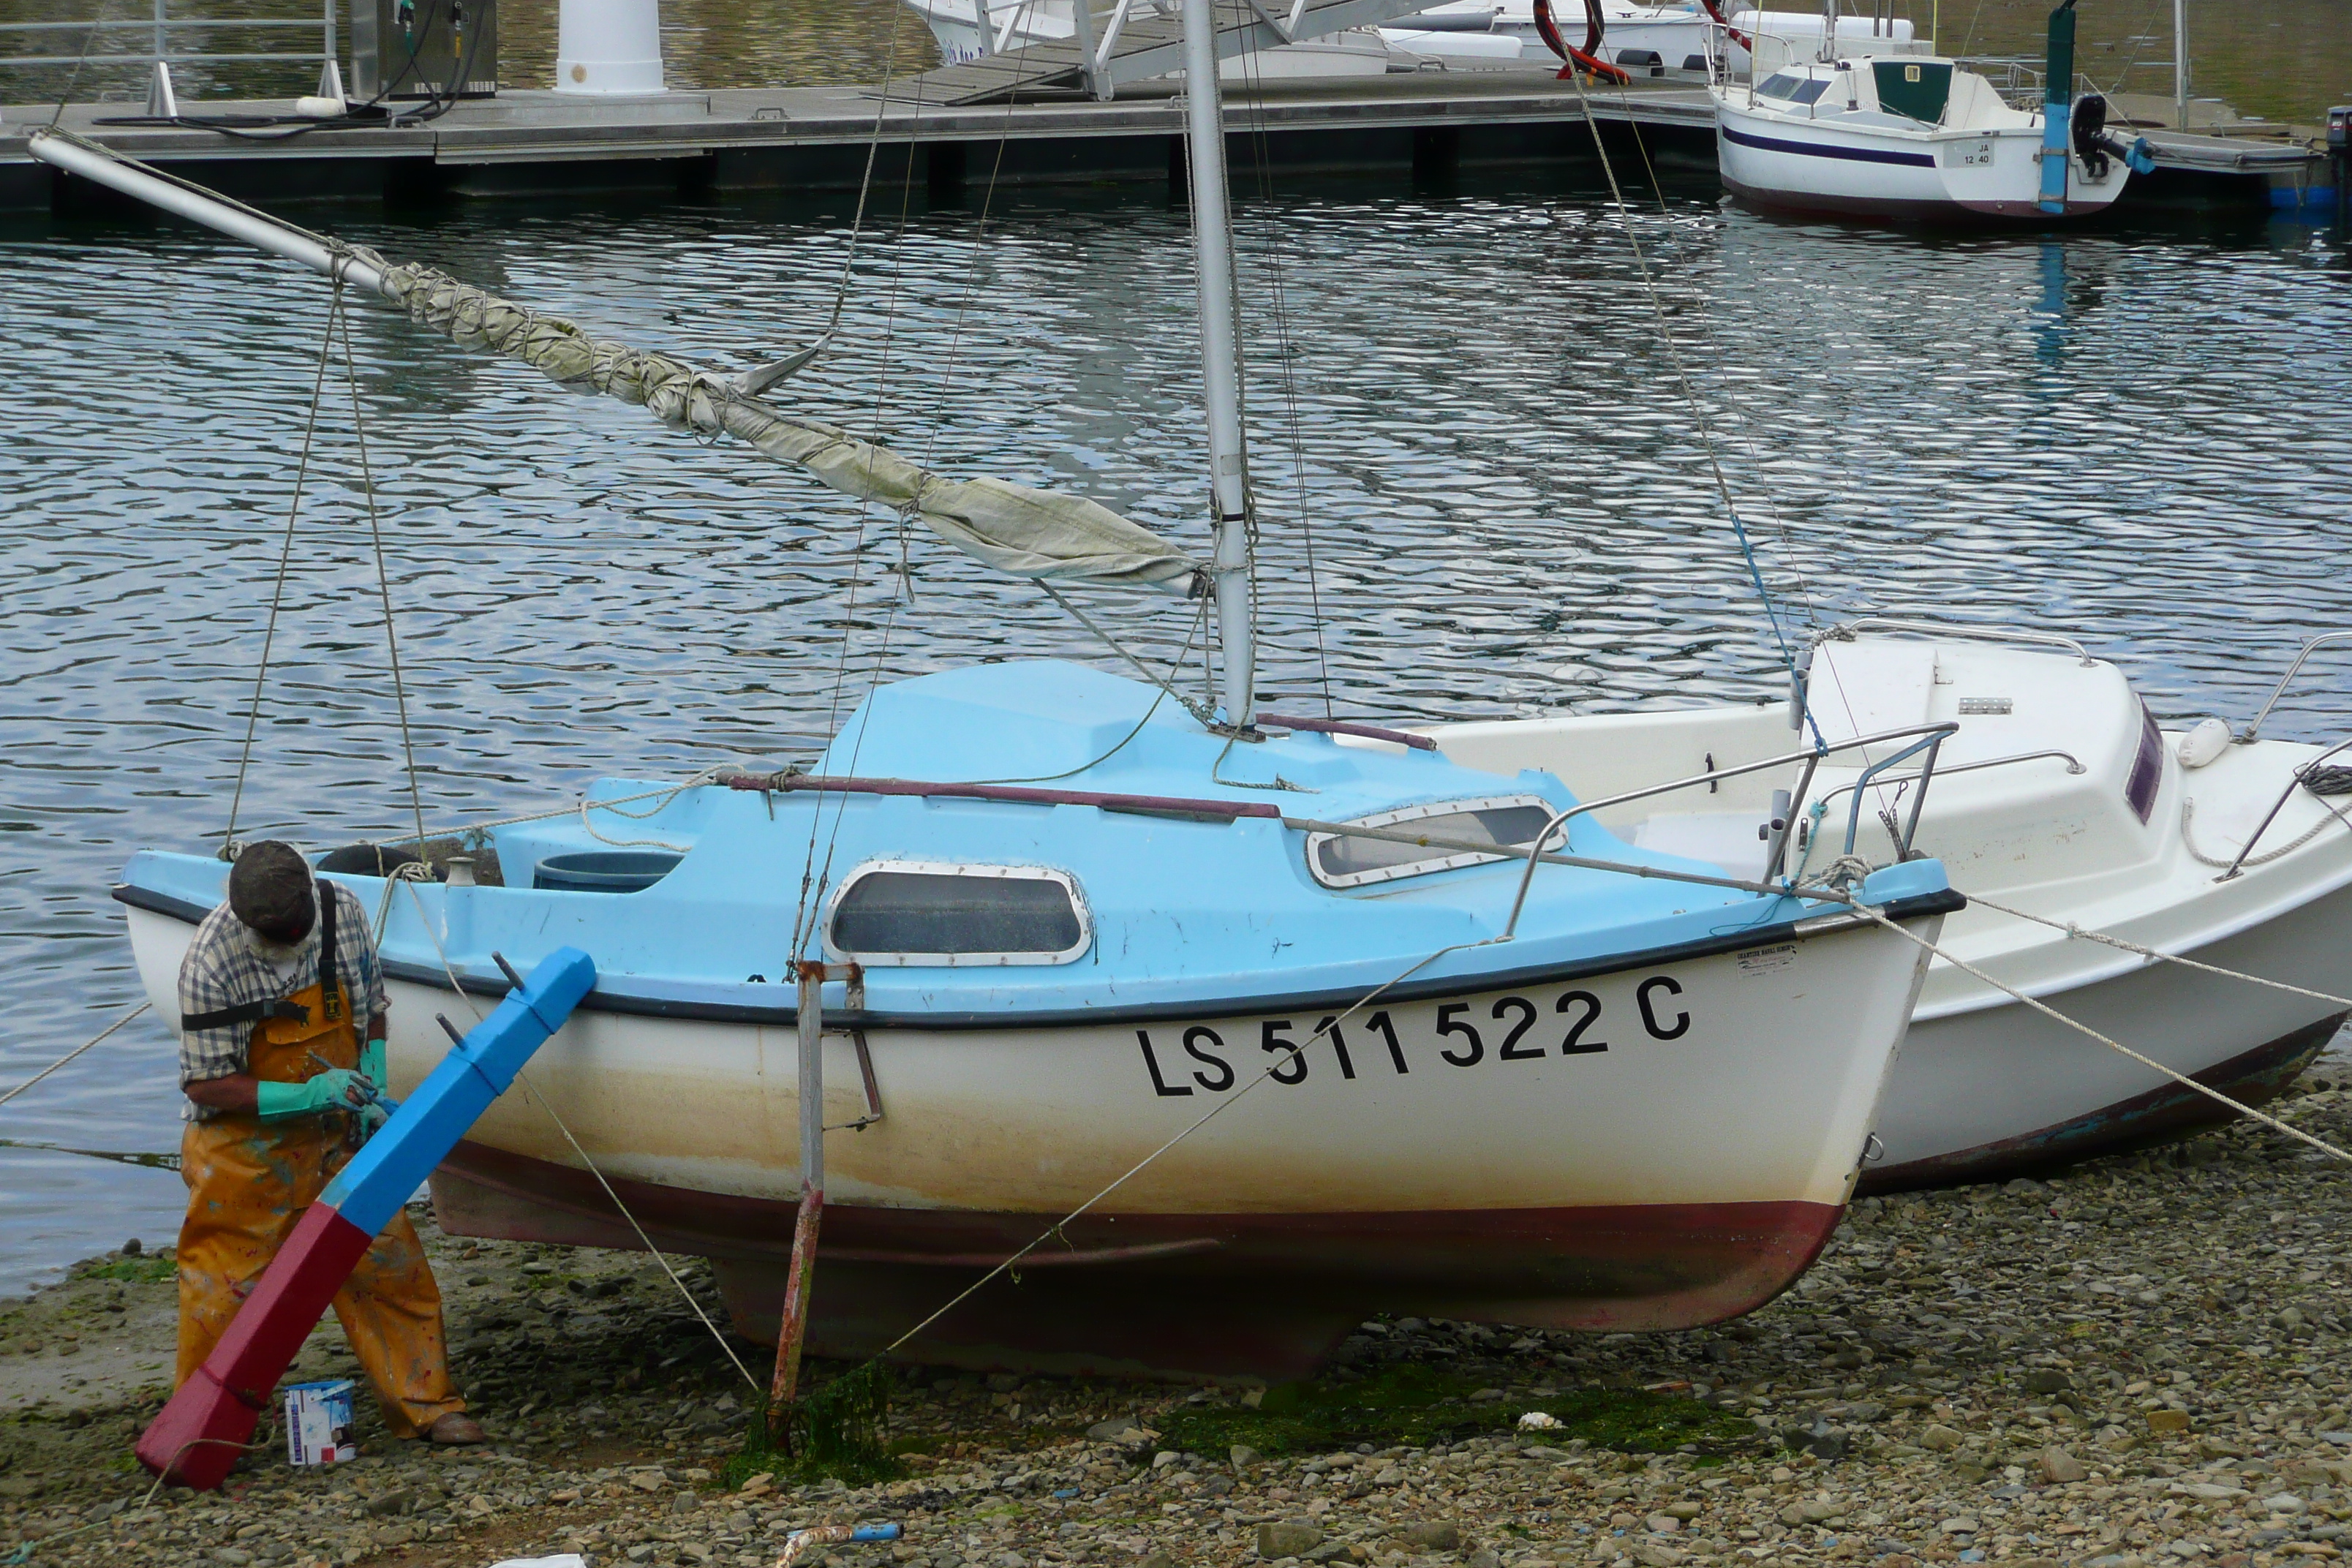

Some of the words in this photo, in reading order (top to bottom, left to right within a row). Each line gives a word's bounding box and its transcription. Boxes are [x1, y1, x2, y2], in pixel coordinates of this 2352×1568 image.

[1979, 144, 1989, 152] JA
[1964, 156, 1974, 164] 12
[1978, 155, 1989, 163] 40
[1137, 1025, 1235, 1097] LS
[1261, 1010, 1409, 1085] 511
[1435, 990, 1609, 1068] 522
[1635, 975, 1691, 1041] C
